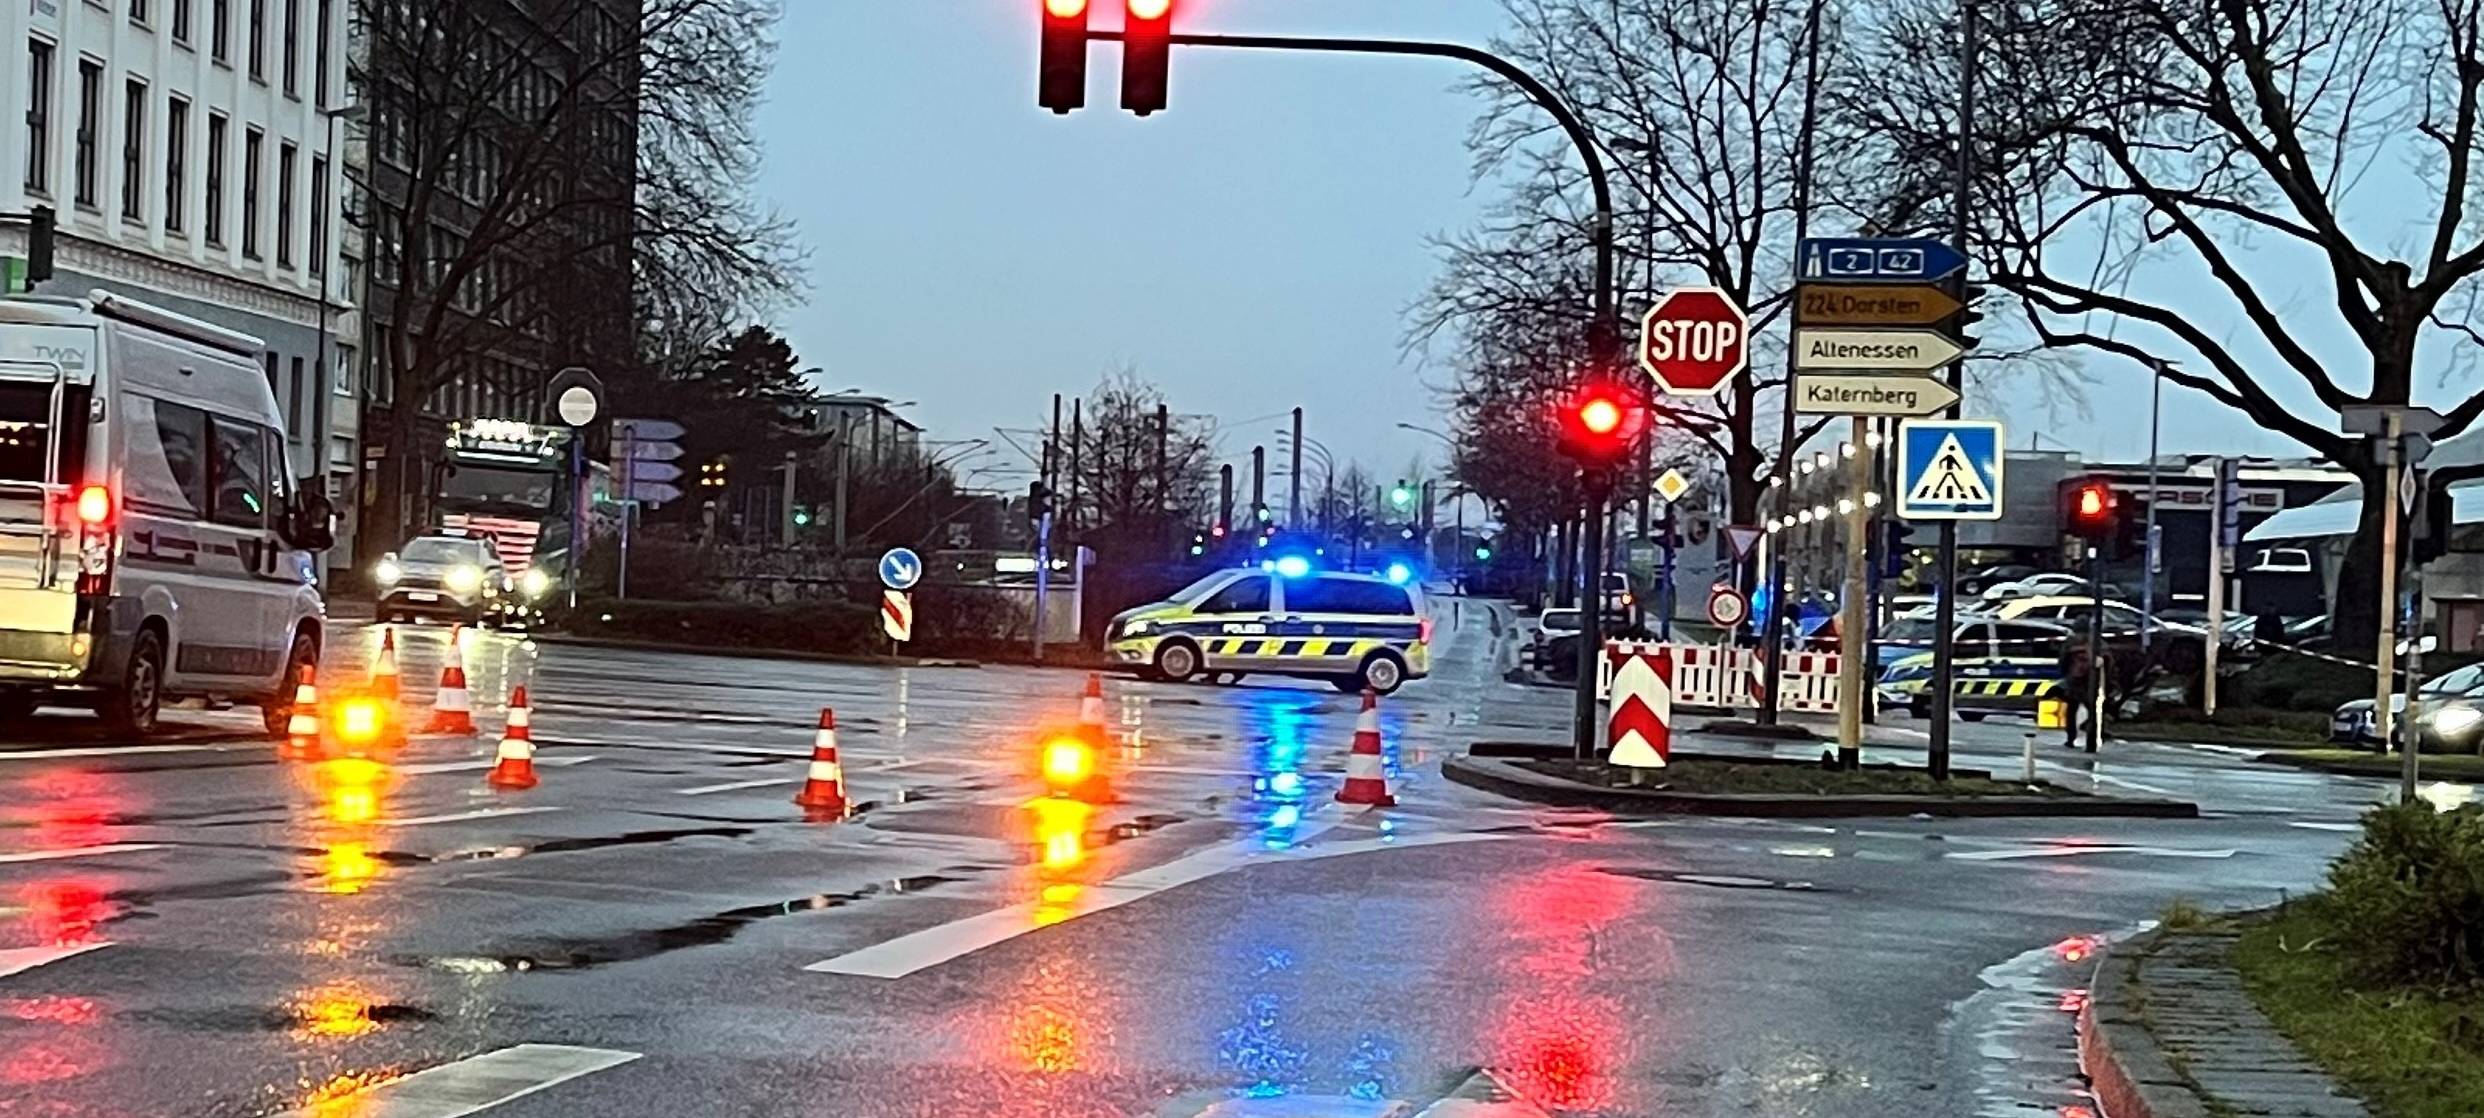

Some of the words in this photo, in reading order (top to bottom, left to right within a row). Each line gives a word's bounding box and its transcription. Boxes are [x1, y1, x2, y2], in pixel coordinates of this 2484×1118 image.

[1846, 254, 1857, 270] 2
[1889, 254, 1913, 269] 42
[1805, 293, 1837, 315] 224
[1842, 295, 1920, 314] Dorsten
[1651, 319, 1737, 362] STOP
[1810, 340, 1919, 358] Altenessen
[1808, 385, 1917, 408] Katernberg
